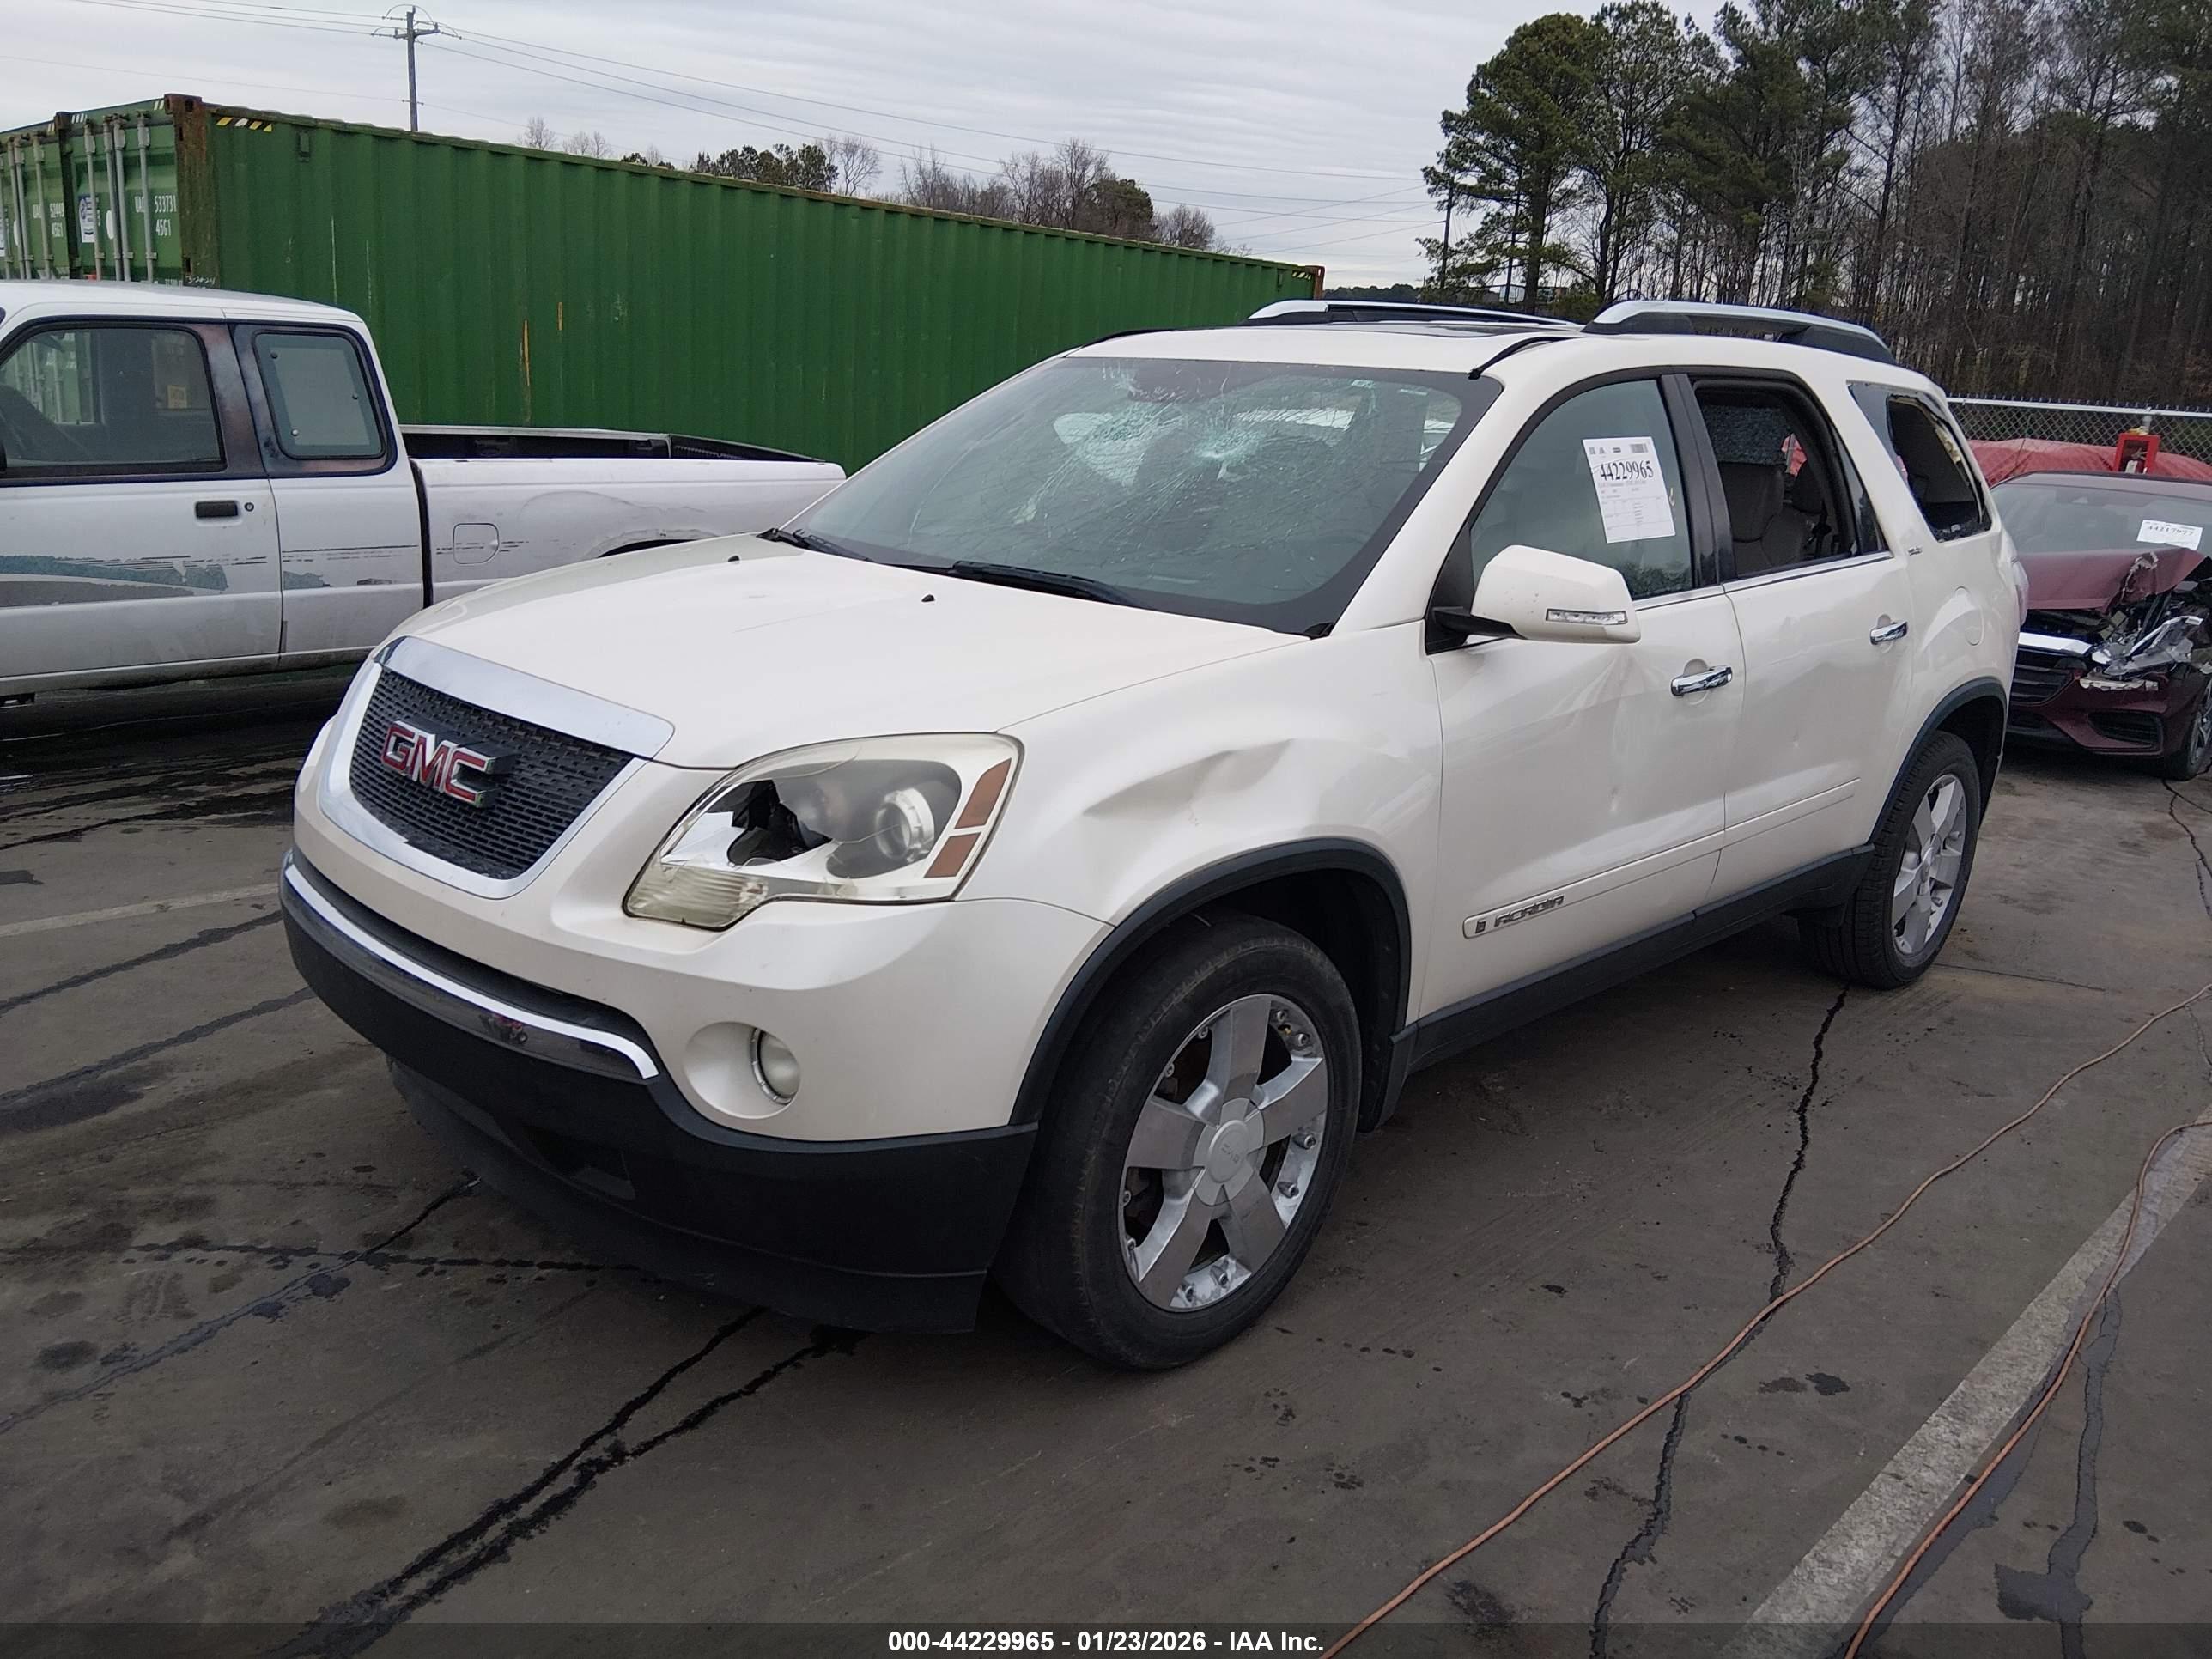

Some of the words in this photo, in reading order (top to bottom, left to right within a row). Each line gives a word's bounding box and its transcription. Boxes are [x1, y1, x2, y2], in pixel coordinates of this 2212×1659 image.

[155, 194, 177, 214] 533731
[1600, 460, 1654, 481] 44229965
[381, 720, 493, 807] GMC
